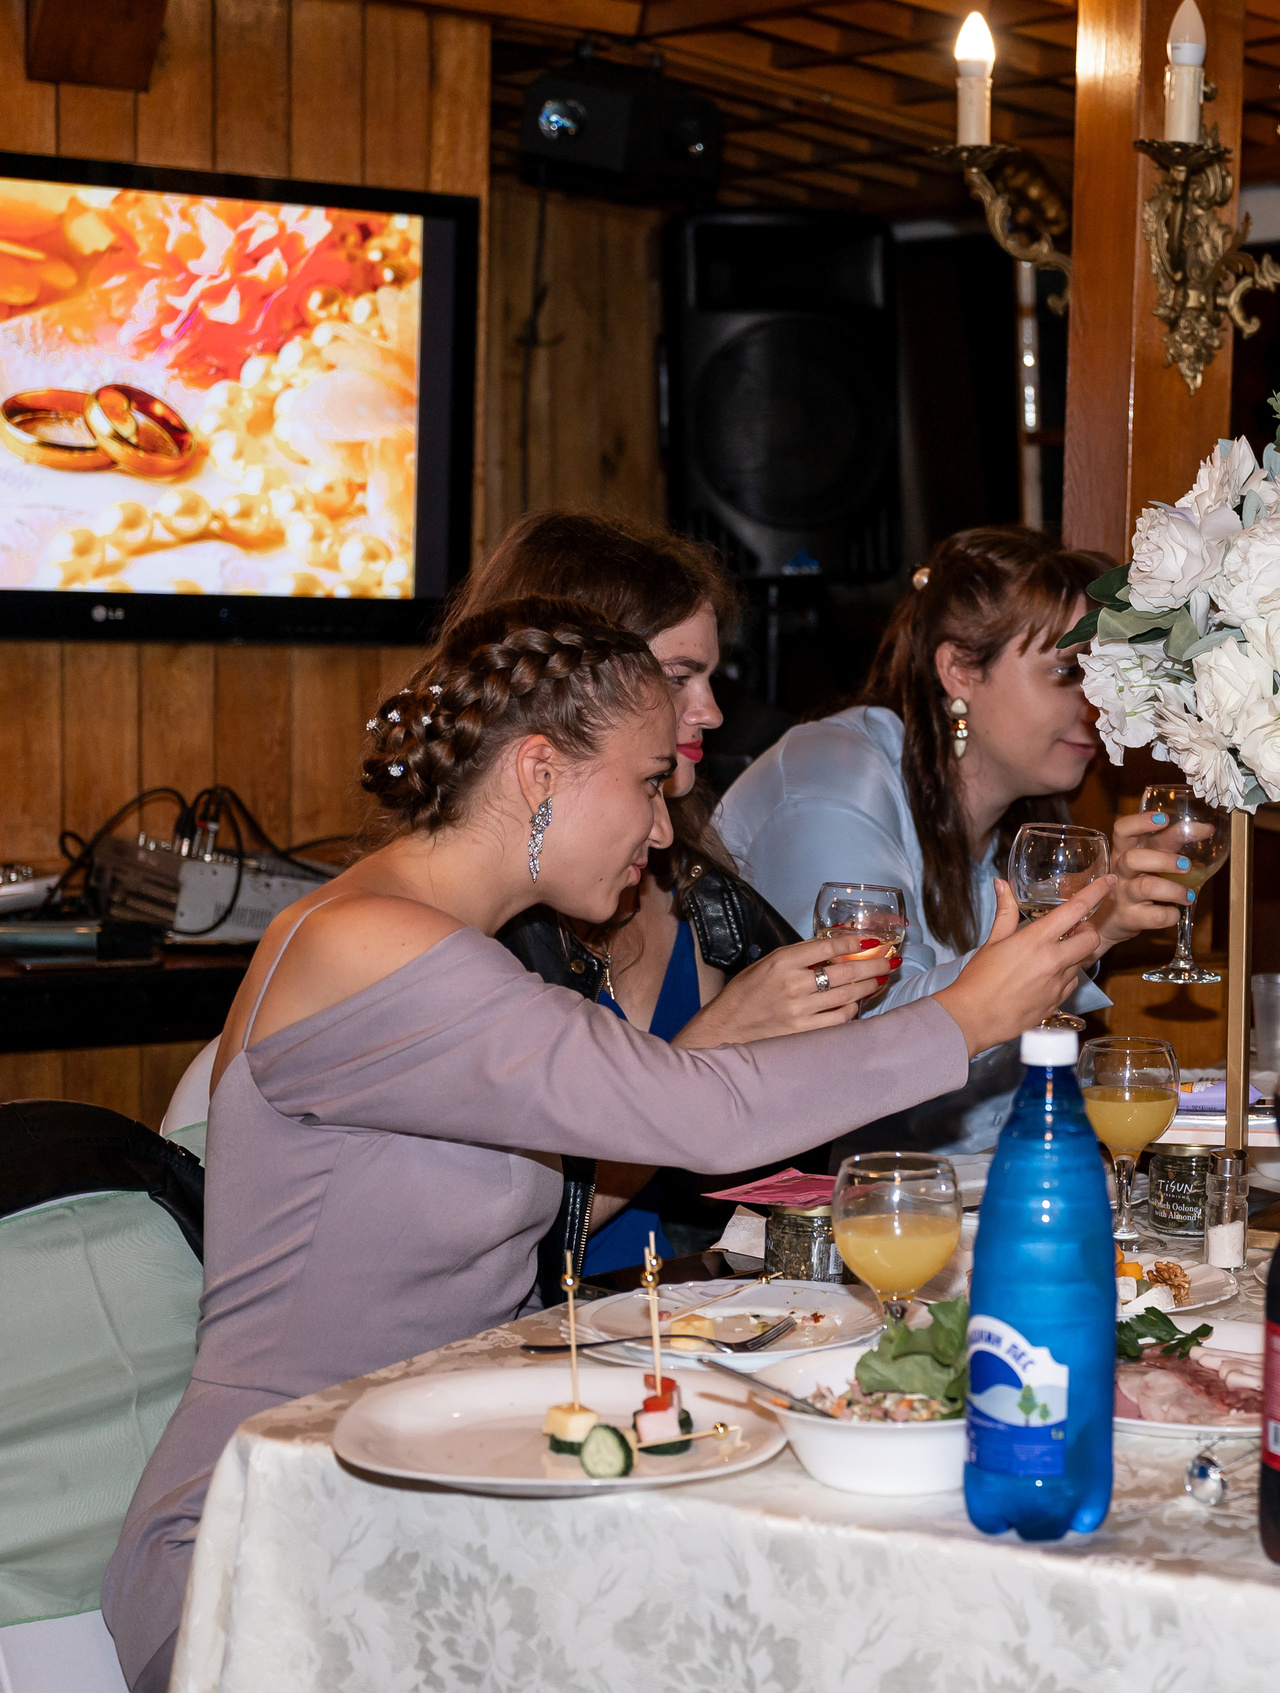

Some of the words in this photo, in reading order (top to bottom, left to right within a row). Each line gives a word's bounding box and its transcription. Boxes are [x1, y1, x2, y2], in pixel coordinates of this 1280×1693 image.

[1154, 1199, 1171, 1210] Peach
[1172, 1202, 1200, 1215] Oolong
[1154, 1209, 1167, 1218] with
[1168, 1211, 1197, 1221] Almond
